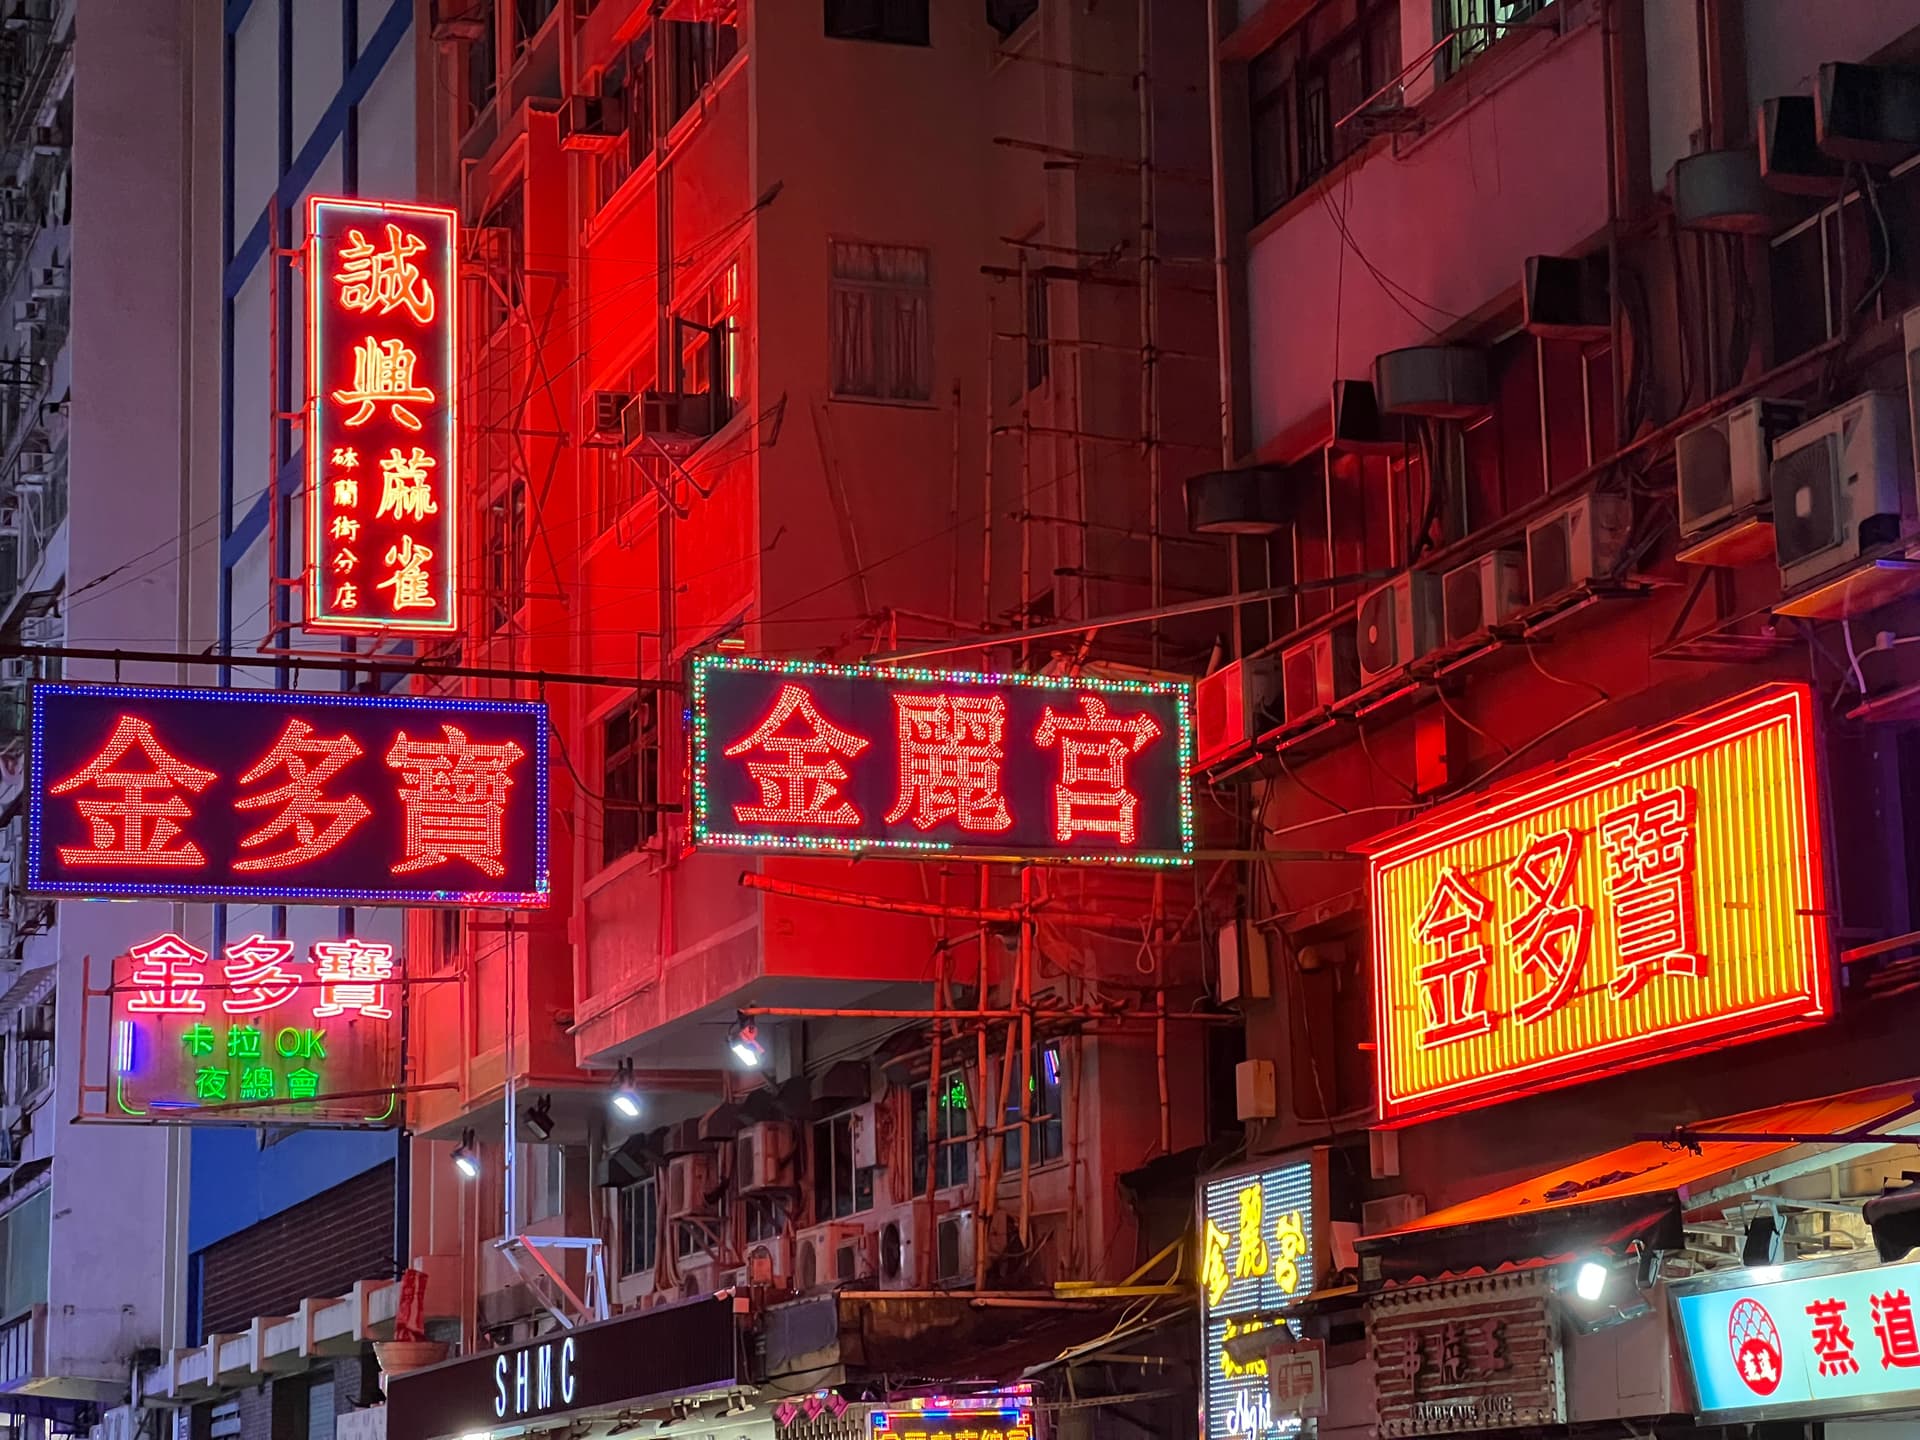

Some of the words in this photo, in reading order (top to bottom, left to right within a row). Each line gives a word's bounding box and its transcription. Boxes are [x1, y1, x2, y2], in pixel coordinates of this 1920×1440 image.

[330, 446, 361, 609] 砵蘭街分店
[49, 714, 526, 878] 金多寶
[722, 684, 1162, 845] 金麗宮
[127, 932, 393, 1020] 金多寶
[1410, 784, 1704, 1051] 金多寶
[194, 1065, 320, 1101] 夜總會
[495, 1336, 576, 1418] SHMC
[1409, 1403, 1478, 1421] BARBECUE
